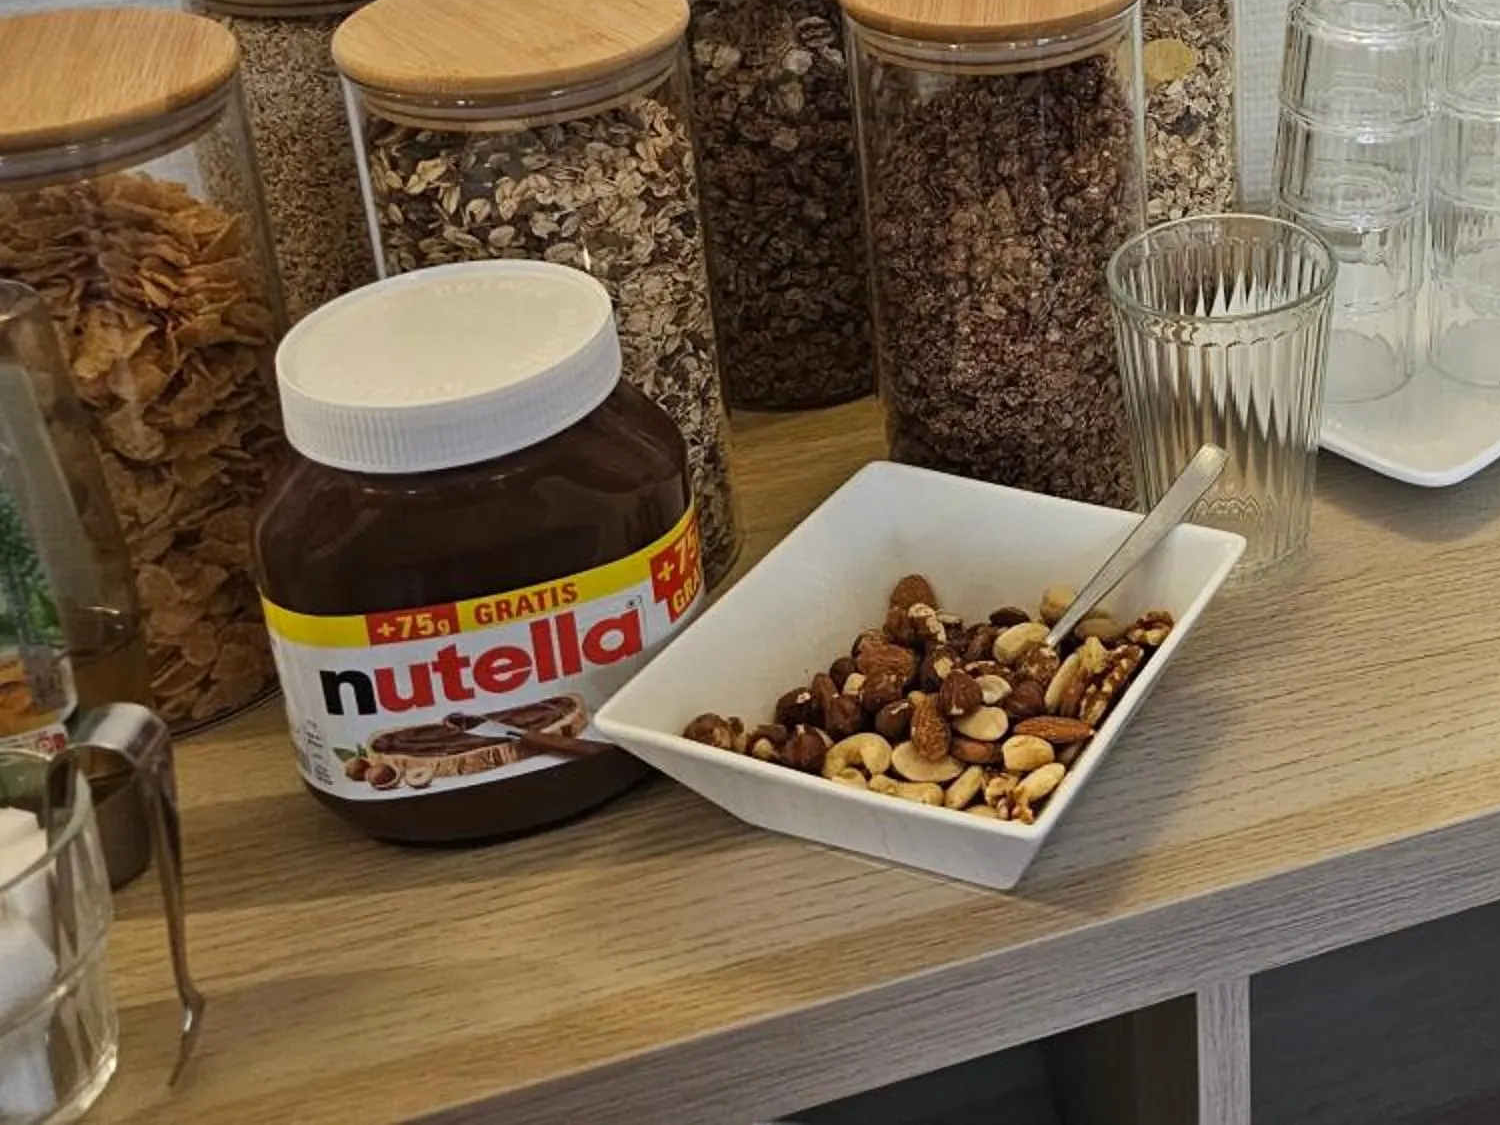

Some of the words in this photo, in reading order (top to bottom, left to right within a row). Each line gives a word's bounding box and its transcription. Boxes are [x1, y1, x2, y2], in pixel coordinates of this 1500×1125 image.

[376, 612, 451, 639] +75g
[474, 583, 578, 625] GRATIS
[319, 608, 643, 716] nutella
